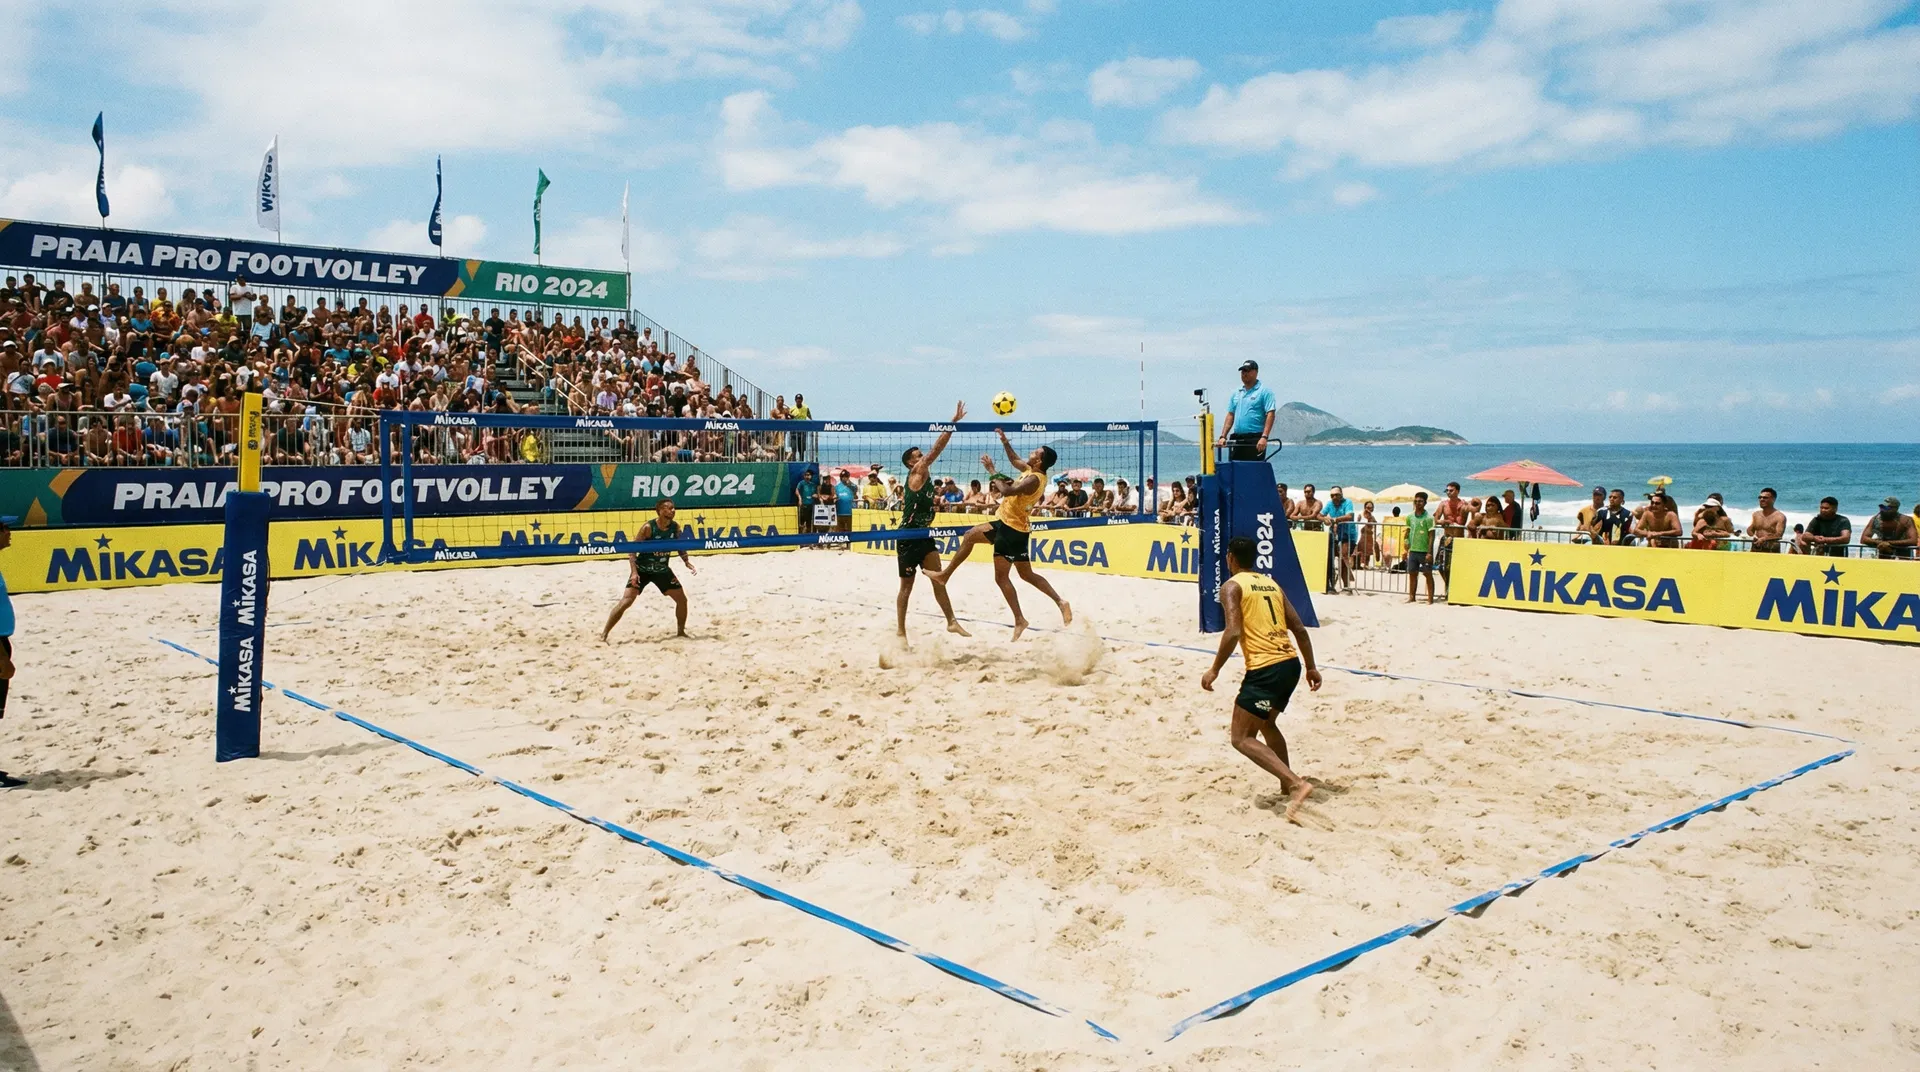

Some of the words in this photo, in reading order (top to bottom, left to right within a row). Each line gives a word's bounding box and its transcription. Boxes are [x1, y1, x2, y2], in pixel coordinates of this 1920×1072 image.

[30, 234, 144, 266] PRAIA
[151, 244, 222, 271] PRO
[227, 250, 427, 285] FOOTVOLLEY
[495, 272, 539, 294] RIO
[542, 276, 608, 299] 2024
[338, 476, 564, 504] FOOTVOLLEY
[631, 474, 680, 498] RIO
[684, 473, 756, 496] 2024
[1030, 538, 1109, 568] KASA
[1256, 512, 1274, 569] 2024
[1263, 595, 1277, 625] 1
